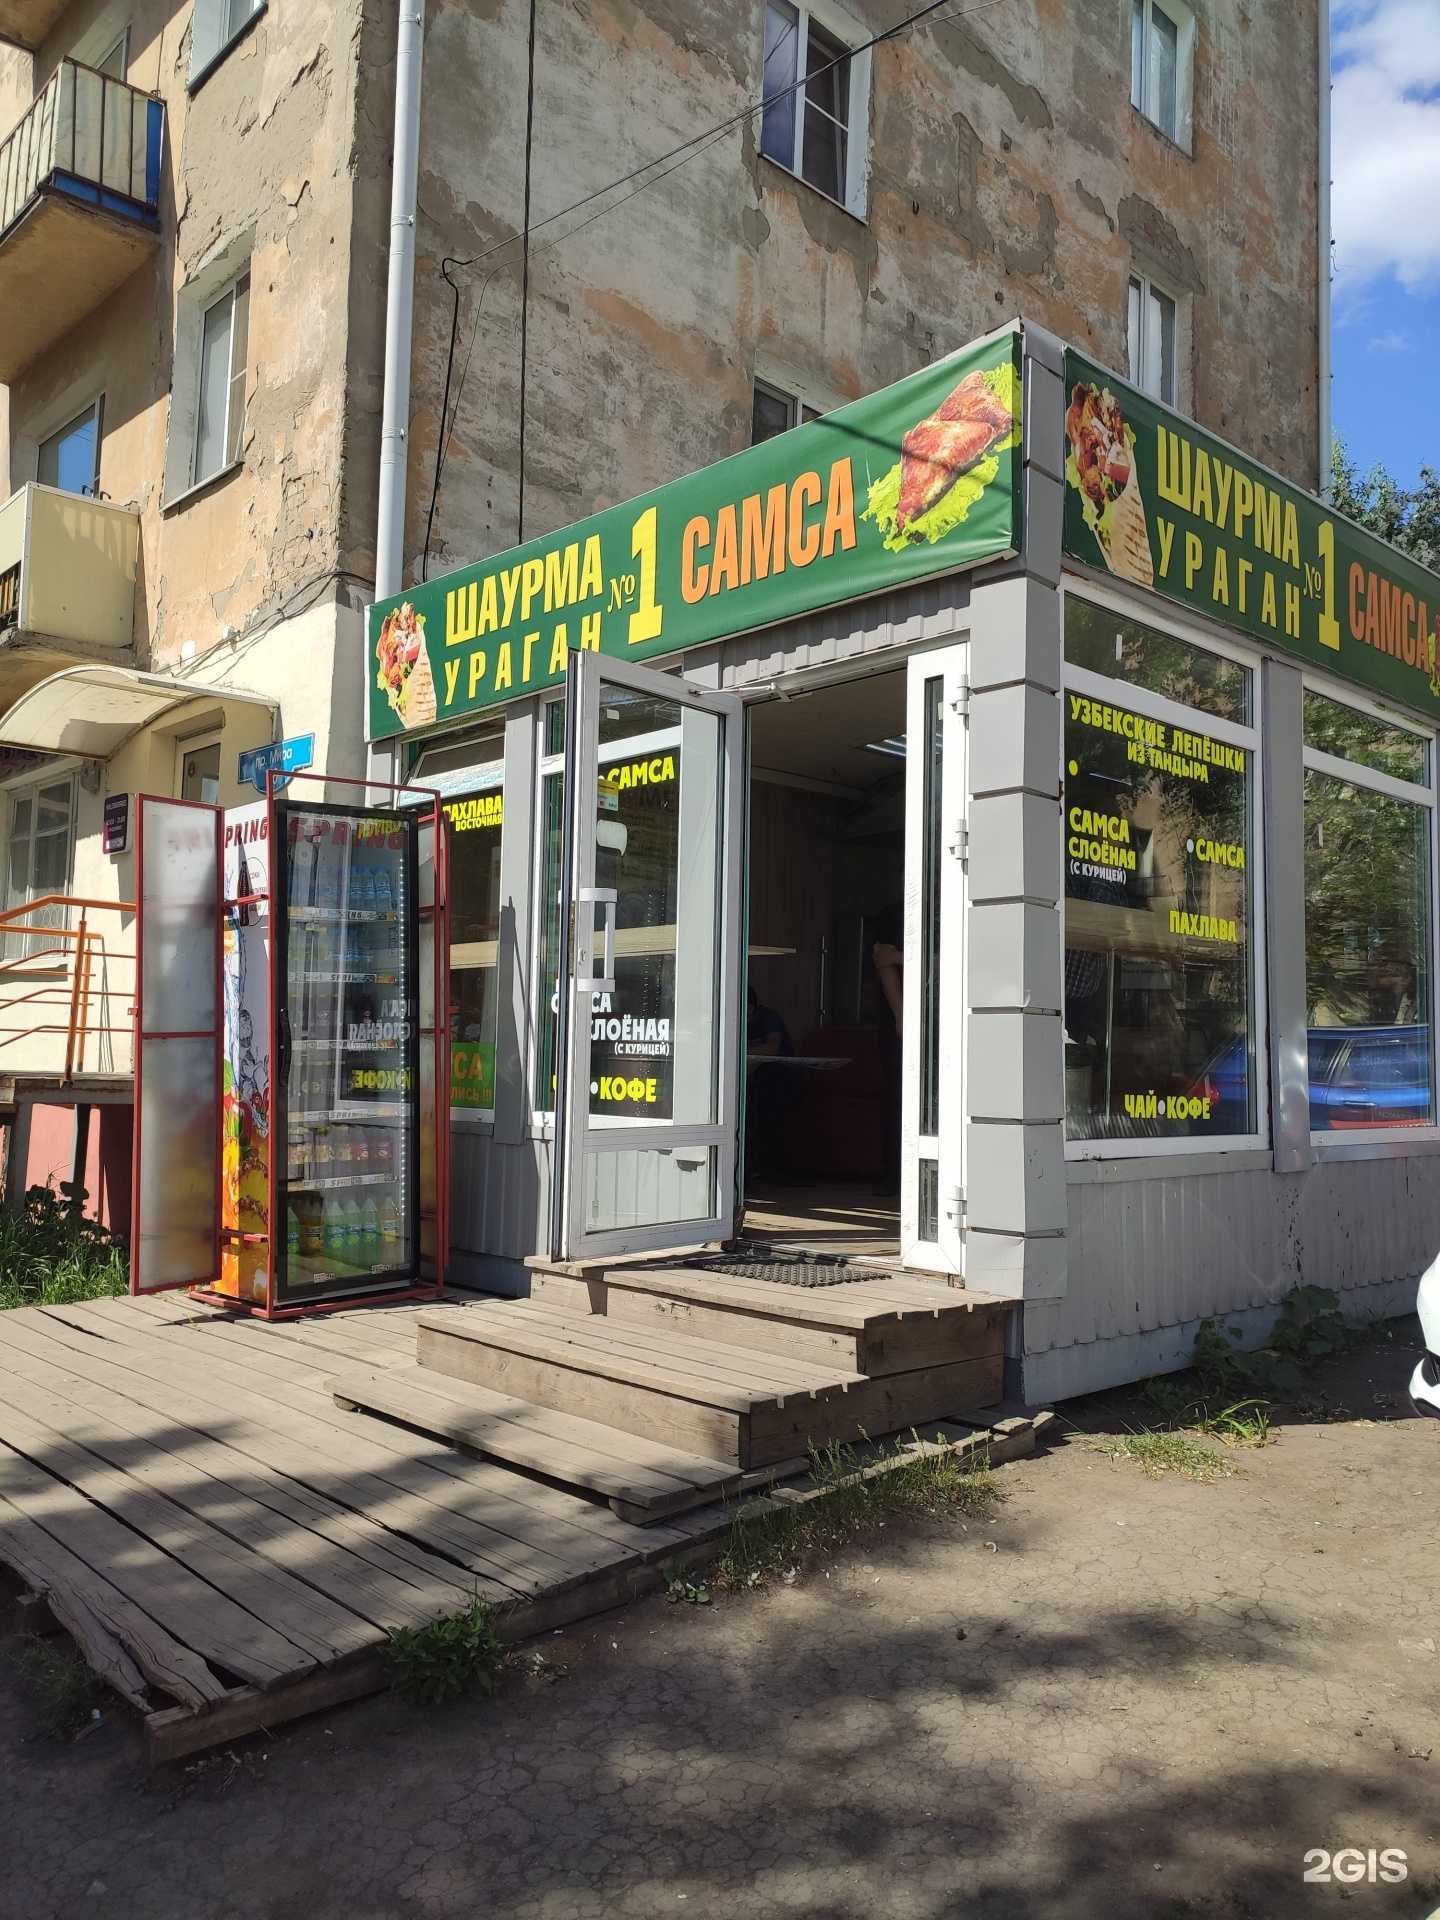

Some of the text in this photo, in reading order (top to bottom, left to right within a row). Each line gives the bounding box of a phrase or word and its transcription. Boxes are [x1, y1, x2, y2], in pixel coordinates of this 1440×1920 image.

[1157, 424, 1300, 570] ШАУРМА
[682, 457, 857, 604] САМСА
[445, 534, 604, 647] ШАУРМА
[1157, 517, 1300, 638] УРАГАН
[1349, 561, 1431, 674] САМСА
[444, 612, 601, 706] УРАГАН
[1070, 695, 1245, 773] УЗБЕКСКИЕ ЛЕПЁШКИ
[608, 756, 675, 790] САМСА
[1127, 740, 1209, 784] ИЗ ТАНДЫРА
[1069, 806, 1130, 844] САМСА
[1068, 836, 1136, 871] СЛОЁНАЯ
[1195, 837, 1246, 869] САМСА
[1168, 908, 1238, 943] ПАХЛАВА
[591, 1014, 670, 1041] ЛОЁНАЯ
[600, 1076, 657, 1103] КОФЕ
[1166, 1095, 1211, 1120] КОФЕ
